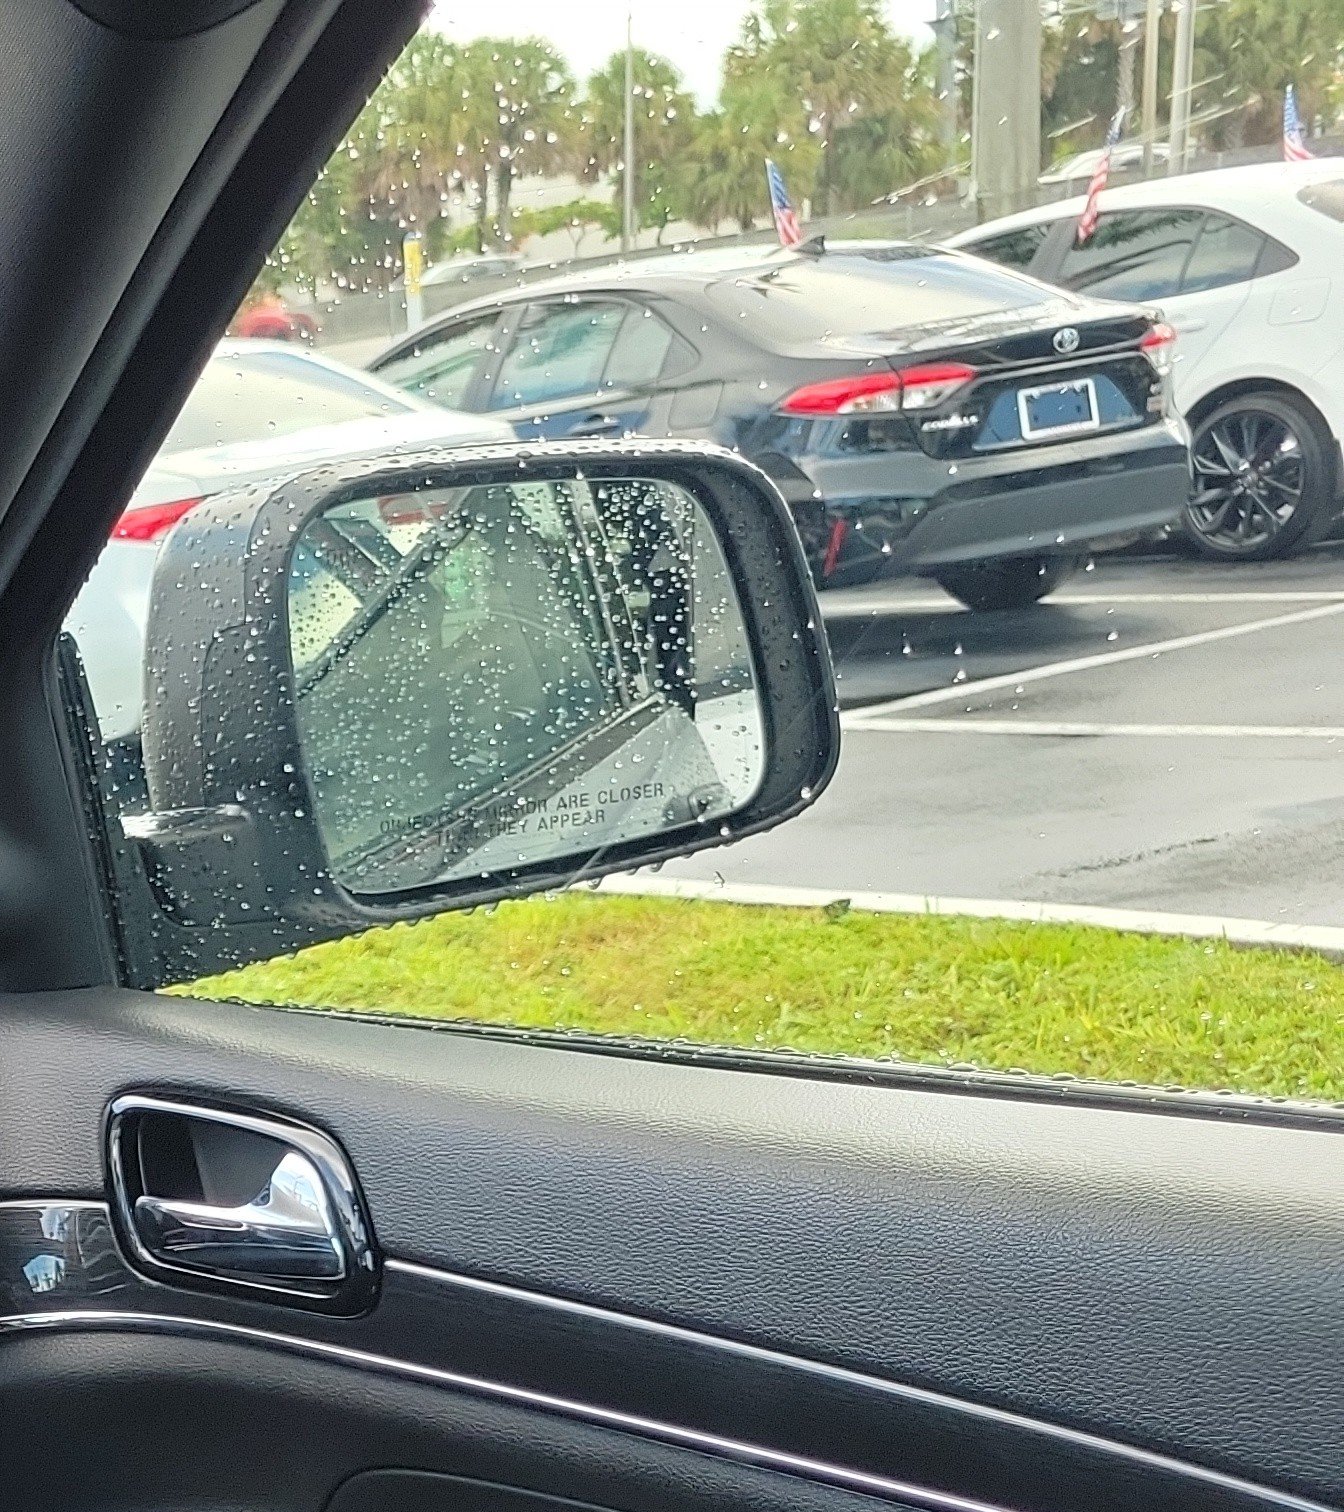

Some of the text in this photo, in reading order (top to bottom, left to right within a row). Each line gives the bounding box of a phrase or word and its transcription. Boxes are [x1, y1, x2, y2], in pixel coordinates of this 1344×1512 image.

[557, 792, 589, 811] ARE
[597, 782, 663, 805] CLOSER
[537, 809, 605, 831] APPEAR
